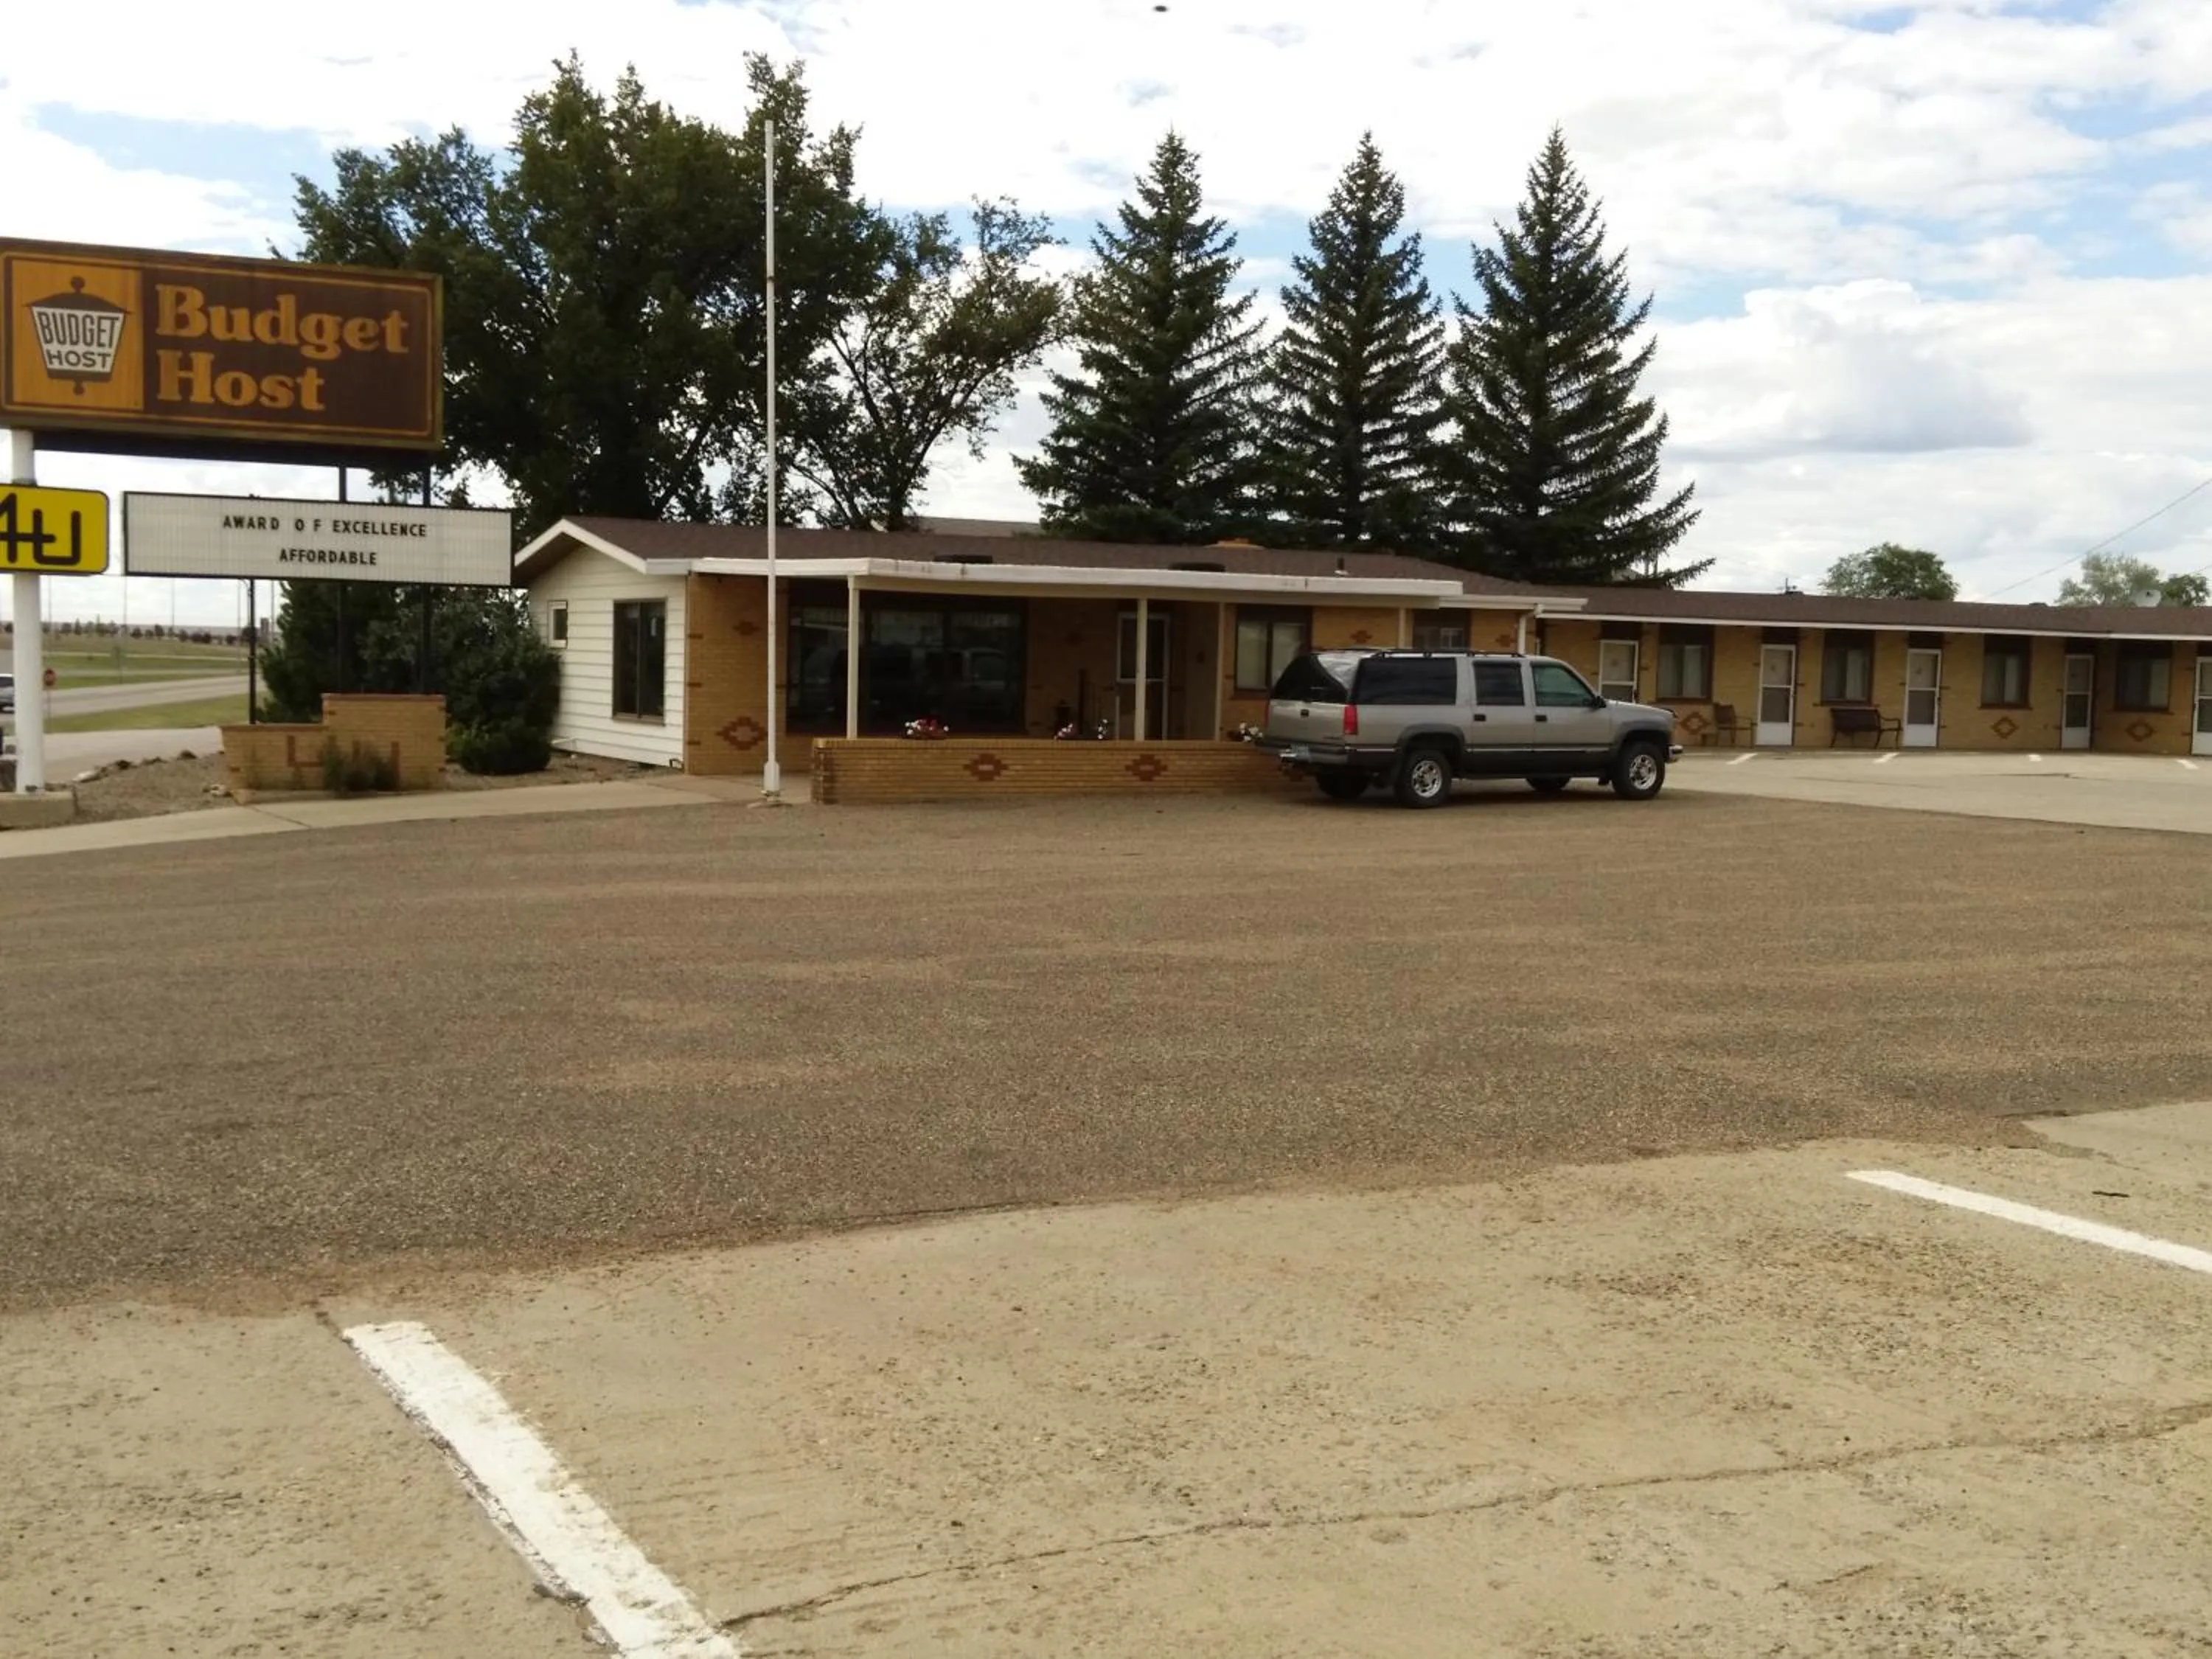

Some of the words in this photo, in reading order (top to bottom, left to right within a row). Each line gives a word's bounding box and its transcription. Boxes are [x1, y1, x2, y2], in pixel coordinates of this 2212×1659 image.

[37, 312, 119, 348] BUDGET
[156, 284, 409, 360] Budget
[46, 349, 111, 369] HOST
[156, 349, 327, 411] Host
[223, 515, 279, 530] AWARD
[333, 520, 427, 537] EXCELLENCE
[279, 549, 377, 566] AFFORDABLE
